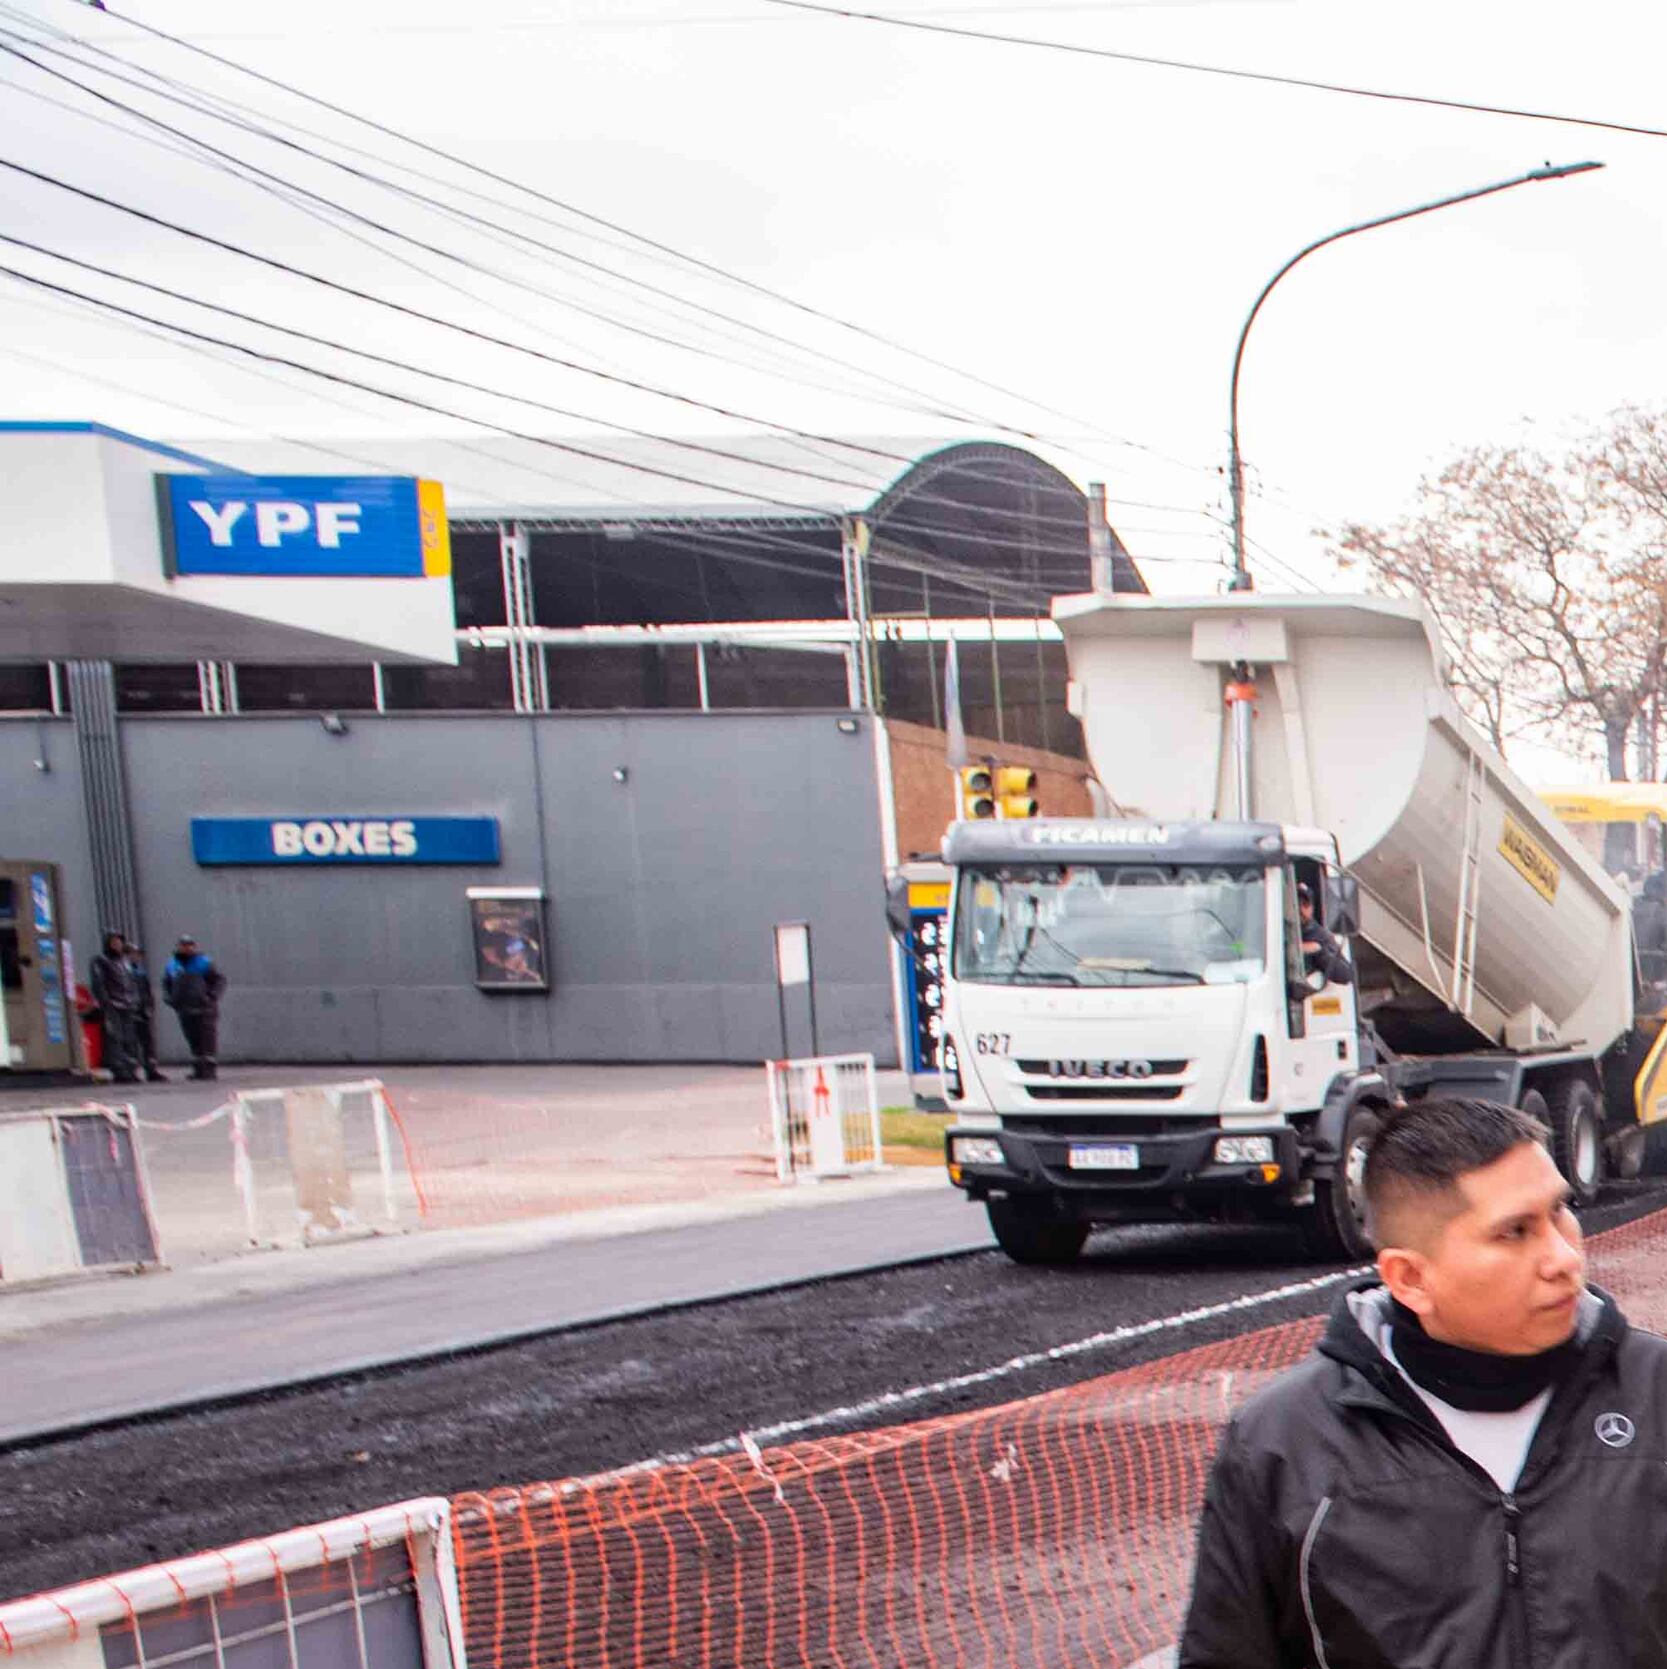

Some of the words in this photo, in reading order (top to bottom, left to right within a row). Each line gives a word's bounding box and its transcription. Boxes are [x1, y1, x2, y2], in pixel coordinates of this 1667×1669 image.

[188, 501, 362, 548] YPF
[272, 822, 416, 856] BOXES
[976, 1032, 1011, 1055] 627
[1048, 1059, 1152, 1078] IVECO
